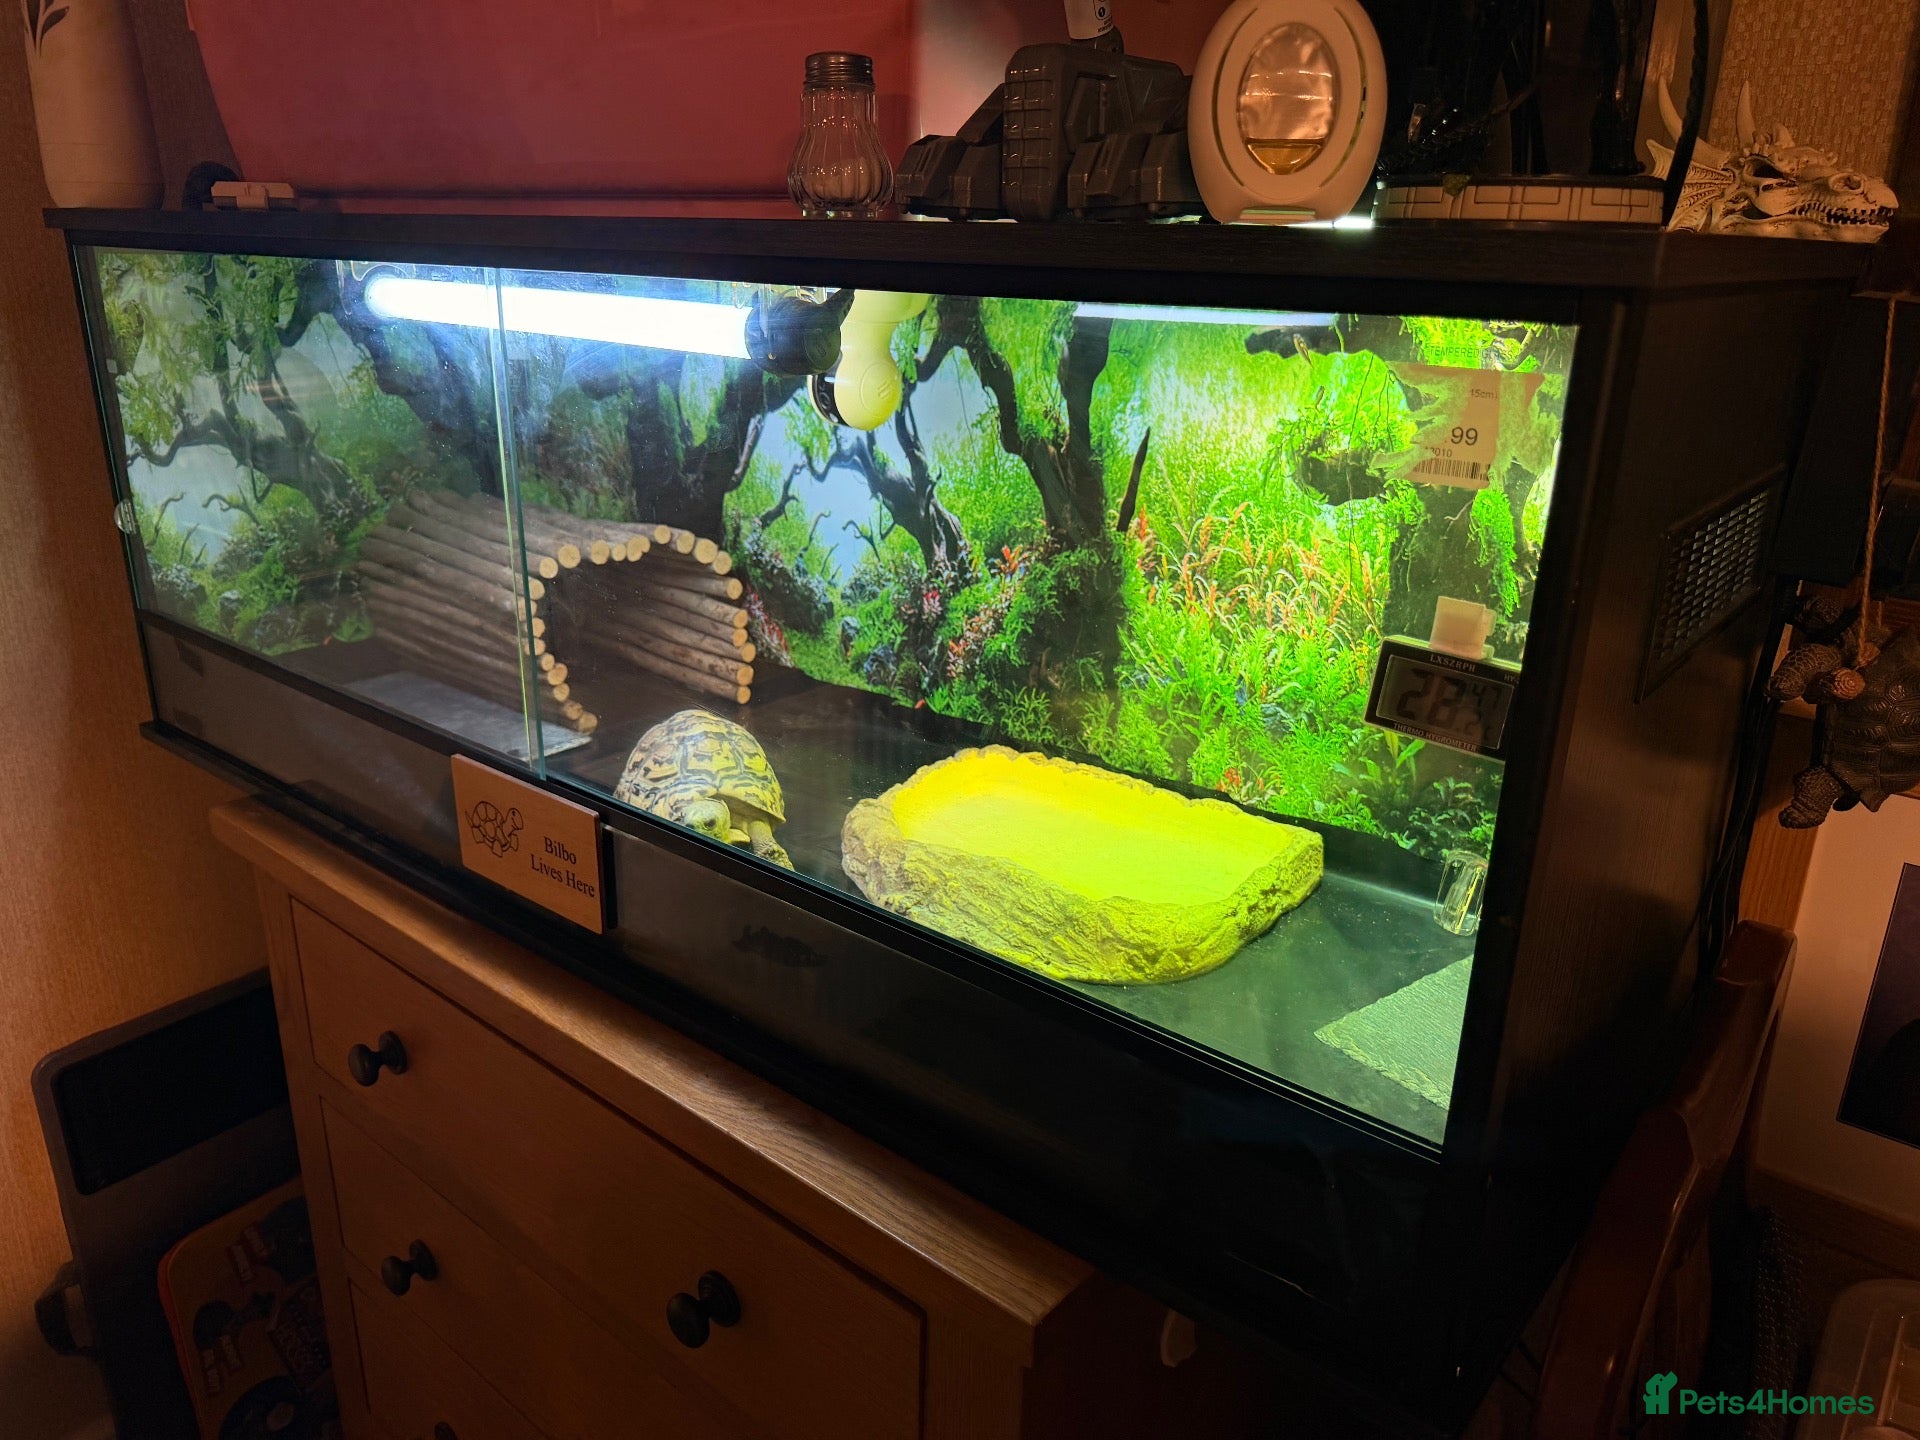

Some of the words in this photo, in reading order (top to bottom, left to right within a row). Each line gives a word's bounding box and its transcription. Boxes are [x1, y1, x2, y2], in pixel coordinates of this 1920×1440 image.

[543, 836, 577, 865] Bilbo
[531, 854, 562, 883] Lives
[566, 869, 595, 898] Here
